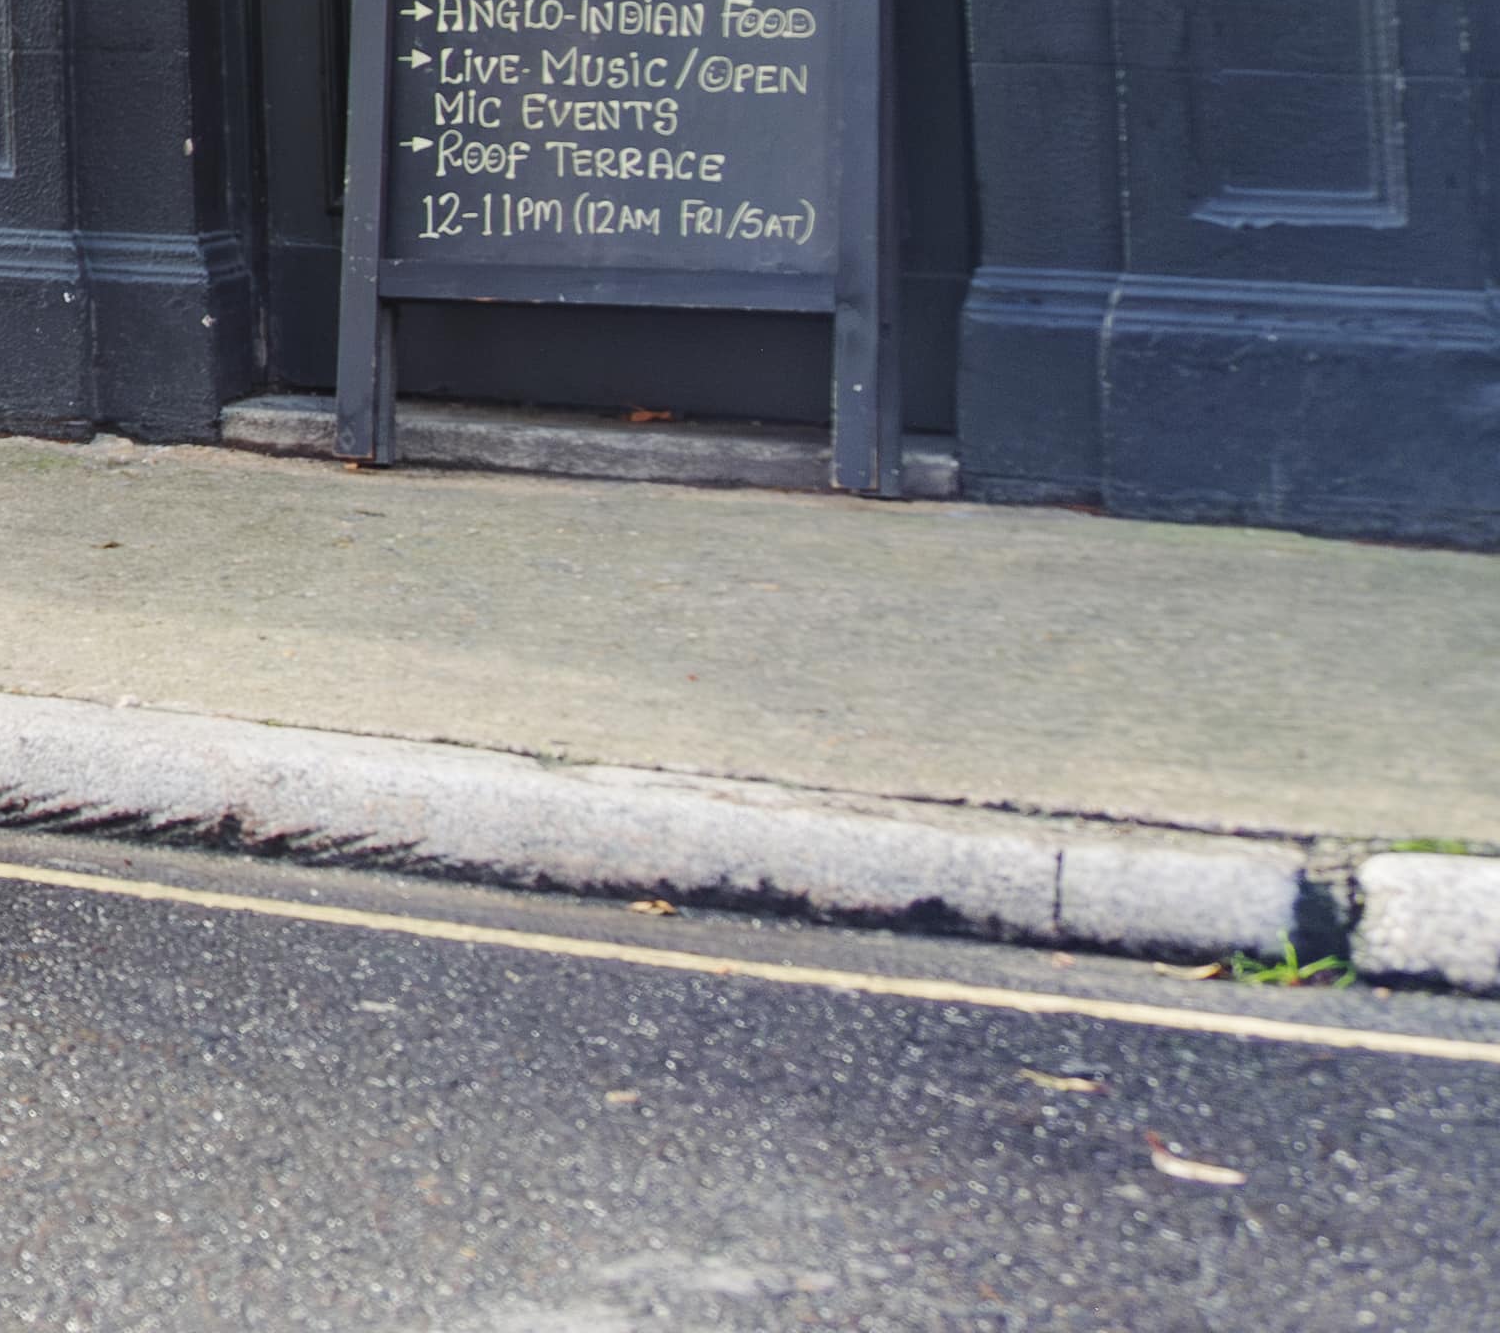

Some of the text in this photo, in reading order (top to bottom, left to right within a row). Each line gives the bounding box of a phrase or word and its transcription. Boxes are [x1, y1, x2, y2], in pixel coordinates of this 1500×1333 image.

[522, 92, 679, 136] EVENTS
[545, 142, 725, 182] TERRACE
[418, 191, 817, 245] 12-11PM (12AM FRI/SAT)
